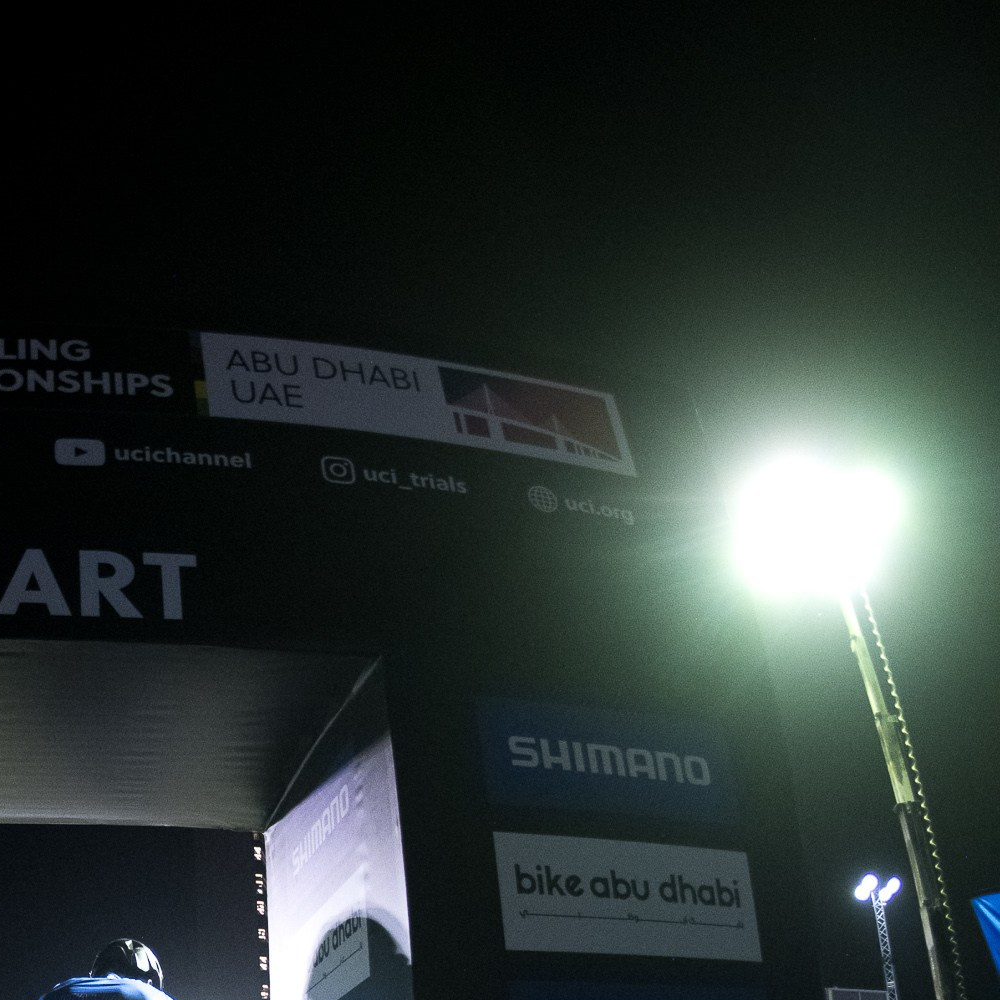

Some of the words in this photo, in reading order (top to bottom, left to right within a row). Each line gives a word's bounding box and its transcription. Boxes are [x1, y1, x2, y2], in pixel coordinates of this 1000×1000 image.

[226, 348, 302, 378] ABU
[312, 356, 421, 393] DHABI
[231, 380, 304, 410] UAE
[114, 444, 253, 470] ucichannel
[363, 465, 468, 495] uci_trials
[564, 497, 635, 526] uci.org
[508, 735, 712, 786] SHIMANO
[514, 863, 583, 897] bike
[590, 869, 649, 901] abu
[660, 873, 741, 909] dhabi
